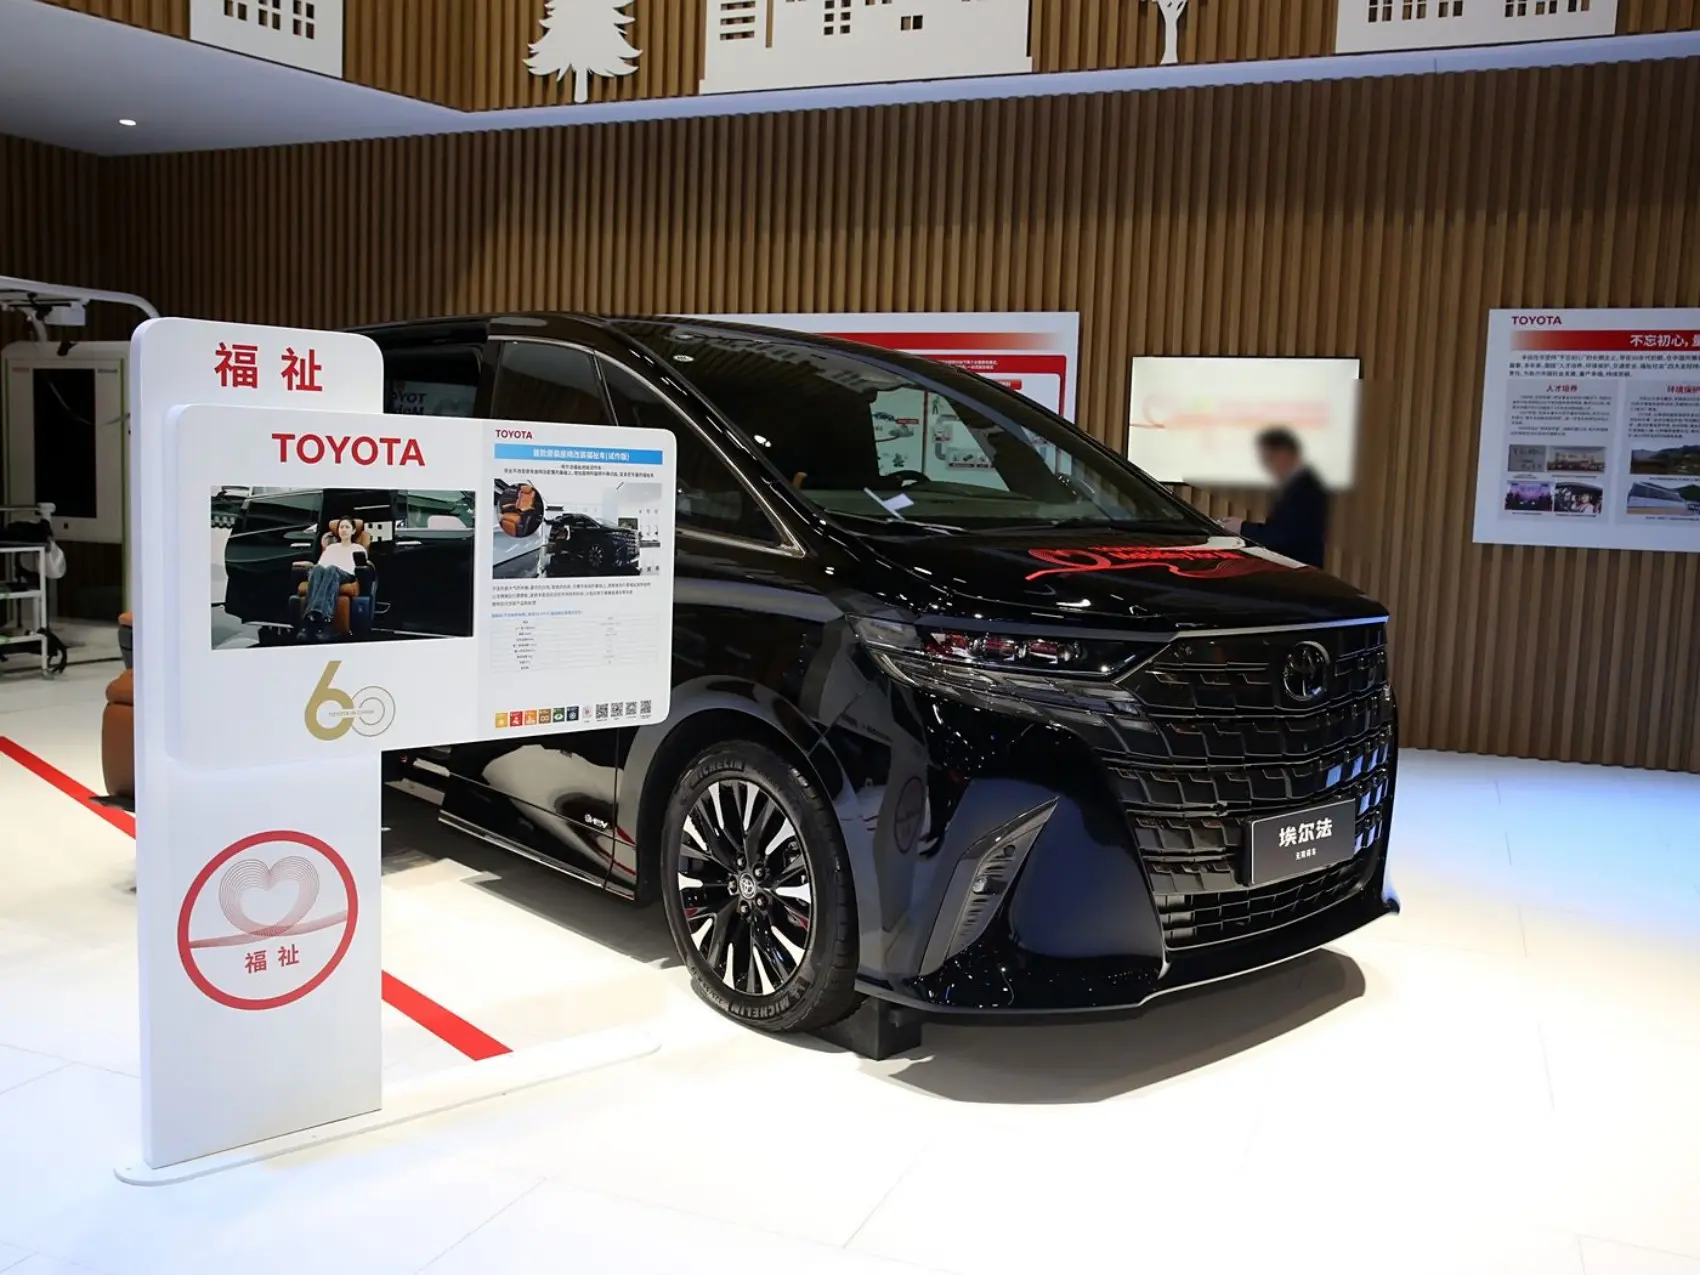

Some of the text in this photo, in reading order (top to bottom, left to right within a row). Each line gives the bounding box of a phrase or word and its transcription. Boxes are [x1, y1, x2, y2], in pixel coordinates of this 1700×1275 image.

[1511, 316, 1562, 325] TOYOTA
[214, 341, 323, 393] 福祉
[495, 429, 533, 440] TOYOTA
[272, 433, 425, 467] TOYOTA
[1278, 817, 1333, 848] 埃尔法
[244, 944, 300, 974] 福祉
[729, 994, 791, 1018] MICHELIN
